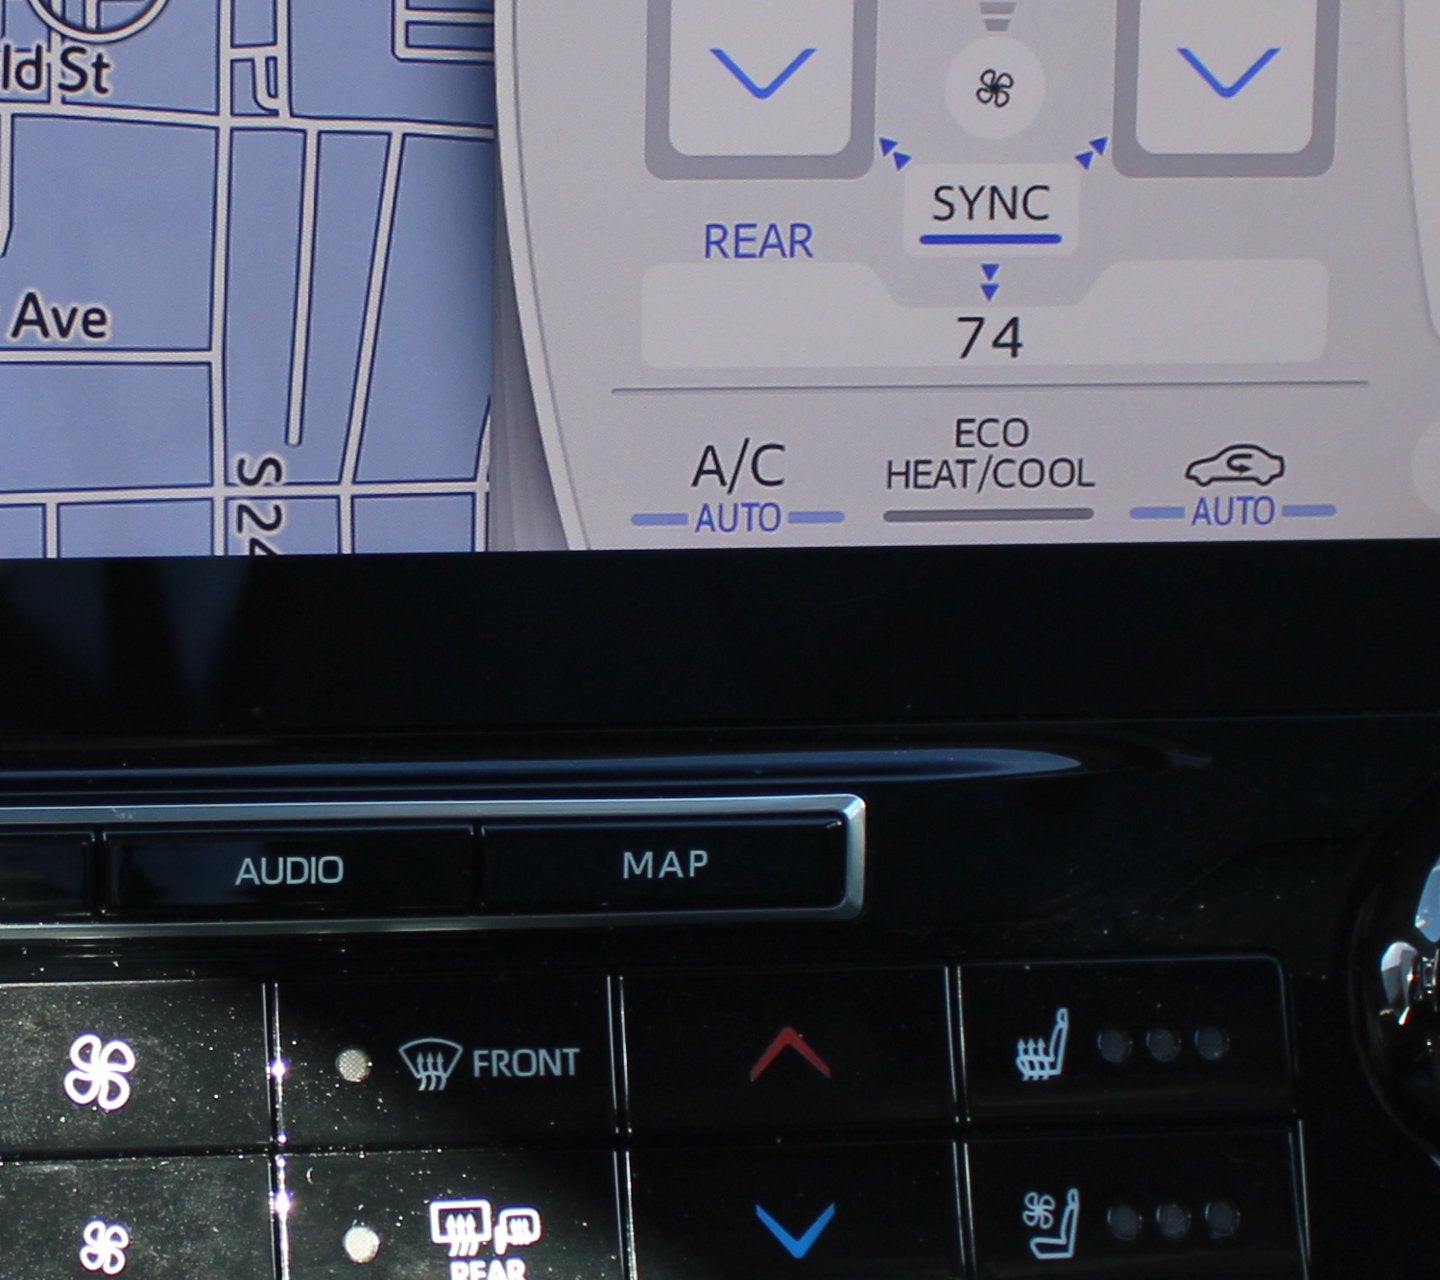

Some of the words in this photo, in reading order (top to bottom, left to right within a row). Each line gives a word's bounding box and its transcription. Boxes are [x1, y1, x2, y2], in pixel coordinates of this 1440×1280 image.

[60, 45, 109, 94] St
[932, 184, 1050, 222] SYNC
[704, 223, 813, 259] REAR
[11, 293, 107, 339] Ave
[957, 316, 1023, 360] 74
[954, 418, 1030, 450] ECO
[238, 457, 282, 486] S
[691, 437, 787, 495] A/C
[886, 456, 1095, 494] HEAT/COOL
[695, 502, 781, 534] AUTO
[1192, 495, 1275, 528] AUTO
[236, 856, 344, 885] AUDIO
[622, 850, 708, 880] MAP
[473, 1048, 579, 1079] FRONT
